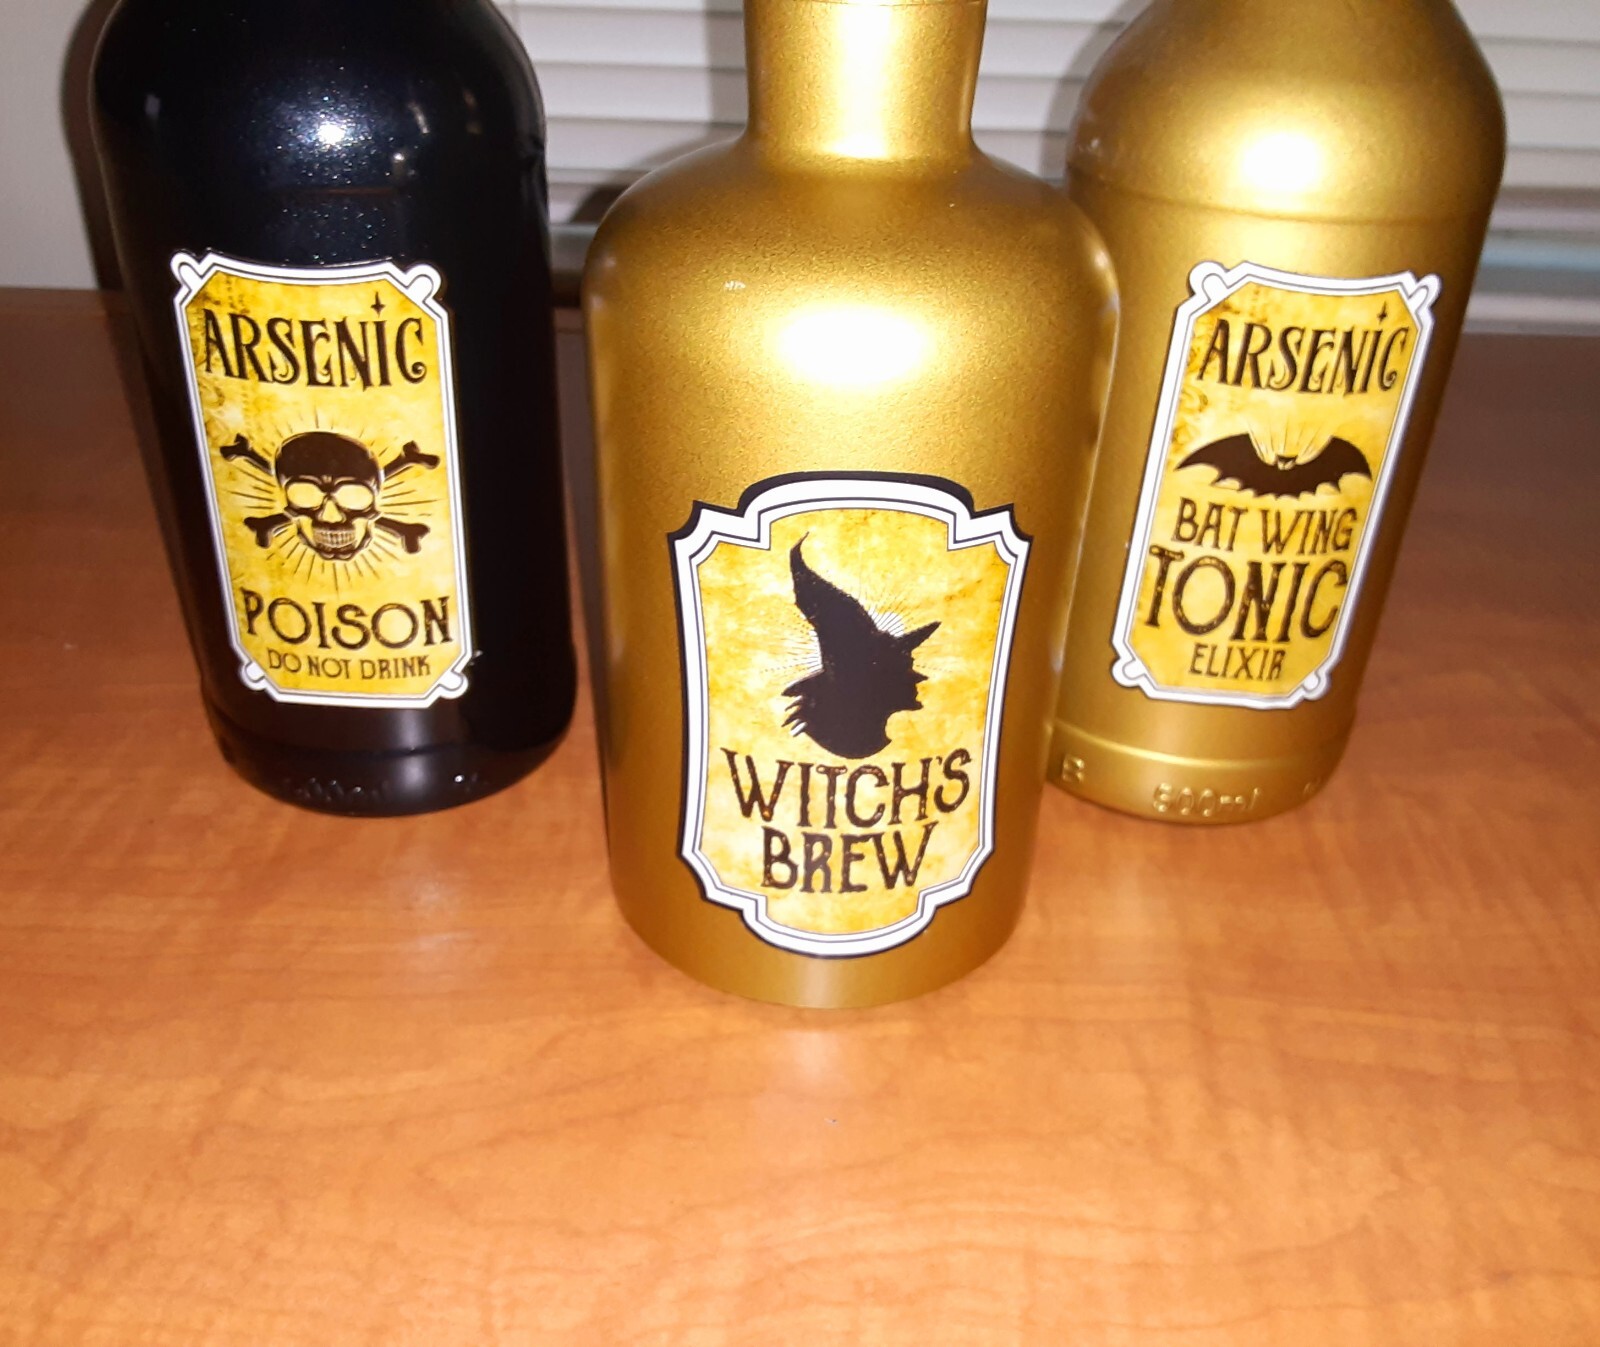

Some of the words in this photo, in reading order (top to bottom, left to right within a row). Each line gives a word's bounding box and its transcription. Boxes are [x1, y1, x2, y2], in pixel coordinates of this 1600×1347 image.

[204, 292, 427, 391] ARSENIC
[1200, 302, 1410, 396] ARSENIC
[1172, 497, 1249, 552] BAT
[1260, 508, 1358, 556] WING
[240, 586, 453, 650] POISON
[1144, 545, 1348, 643] TONIC
[267, 648, 302, 673] DO
[307, 655, 352, 679] NOT
[360, 653, 432, 680] DRINK
[1189, 643, 1288, 682] ELIXIR
[720, 747, 972, 829] WITCH'S
[760, 821, 940, 893] BREW
